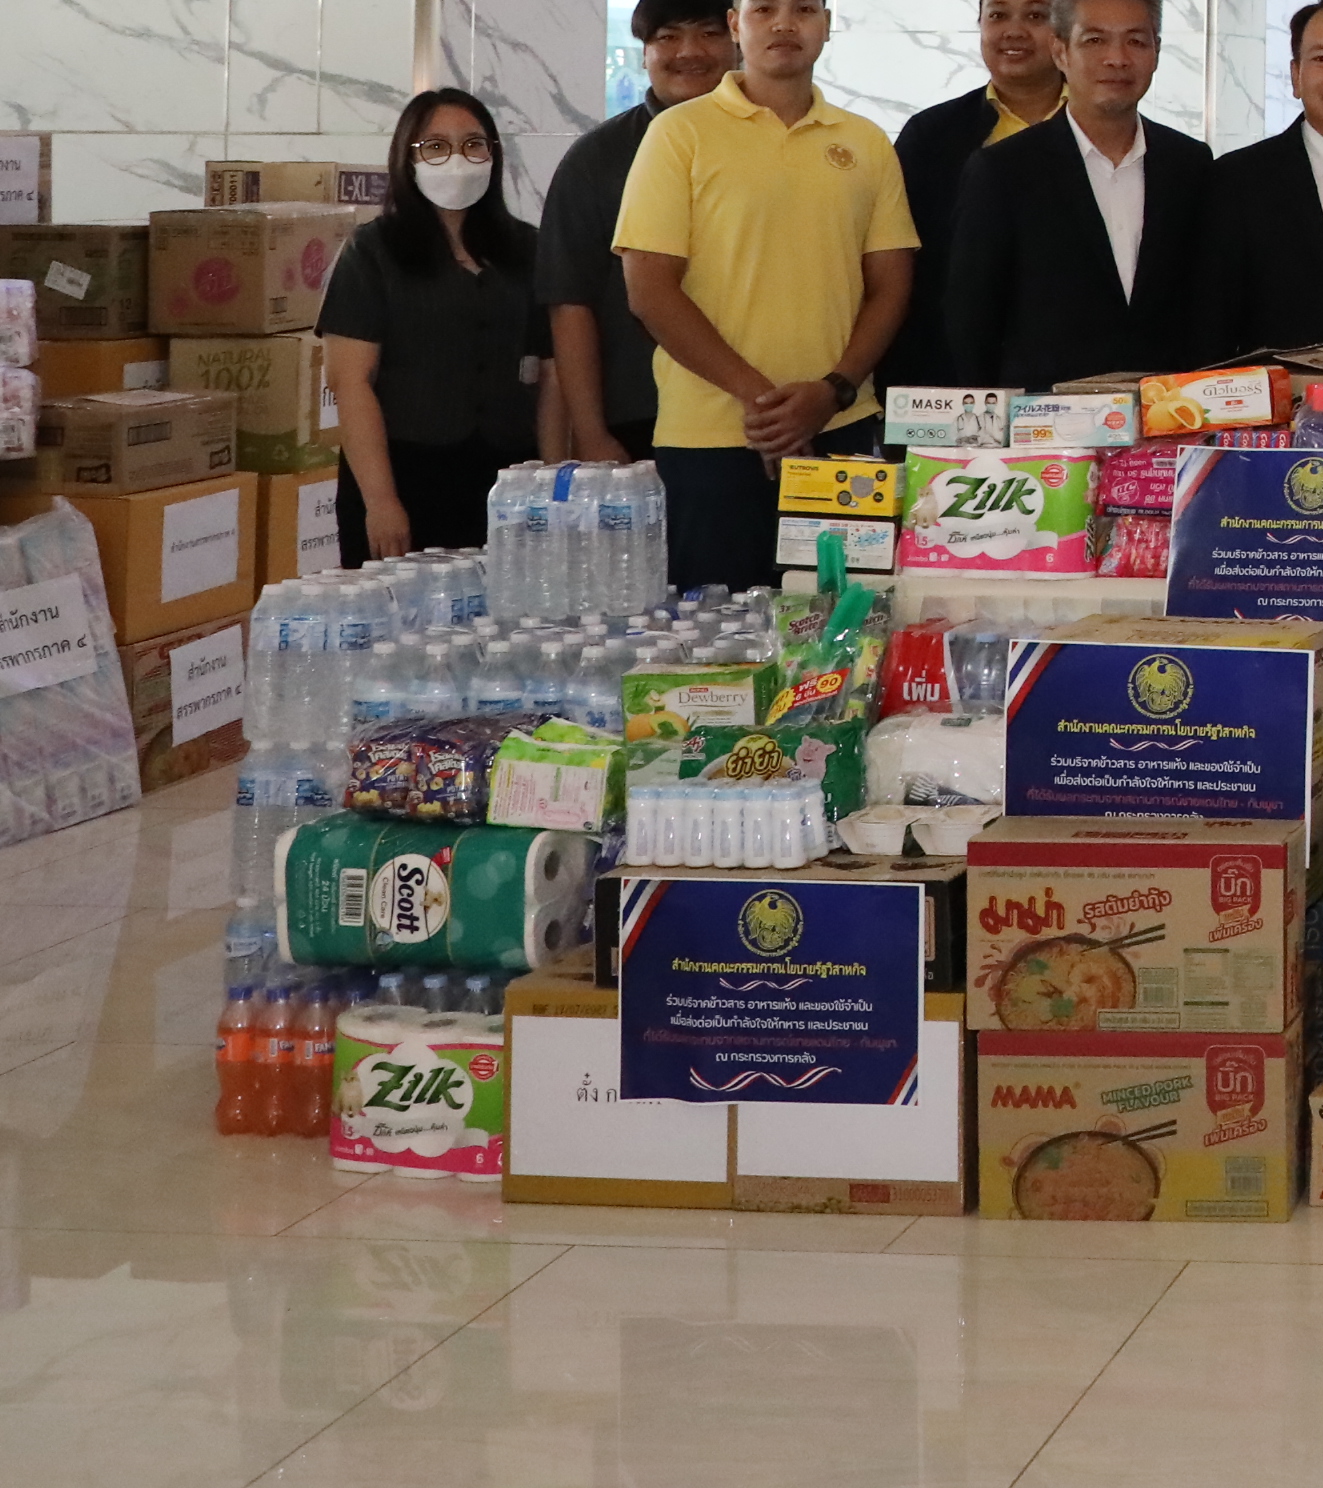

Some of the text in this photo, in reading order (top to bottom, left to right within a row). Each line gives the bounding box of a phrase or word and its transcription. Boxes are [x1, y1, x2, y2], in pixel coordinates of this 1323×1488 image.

[911, 398, 954, 411] MASK
[939, 475, 1037, 519] Zilk
[1046, 553, 1053, 563] 6
[1212, 549, 1288, 561] ร่วมบริจาคข้าวสาร
[678, 691, 748, 706] Dewberry
[903, 671, 941, 702] เพิ่ม
[726, 740, 783, 780] ยำยำ
[1051, 756, 1260, 774] ร่วมบริจาคข้าวสาร และของใช้จำเป็น
[1198, 780, 1256, 792] และประชาชน
[1219, 869, 1251, 896] บิ๊ก
[397, 863, 425, 934] Scott
[979, 886, 1065, 936] มาม่า
[1083, 888, 1172, 919] รสต้มยำกุ้ง
[364, 1061, 465, 1112] Zilk
[1216, 1060, 1253, 1088] บิ๊ก
[991, 1085, 1077, 1110] MAMA
[1101, 1075, 1194, 1105] MINCED PORK
[1118, 1091, 1181, 1113] FLAVOUR
